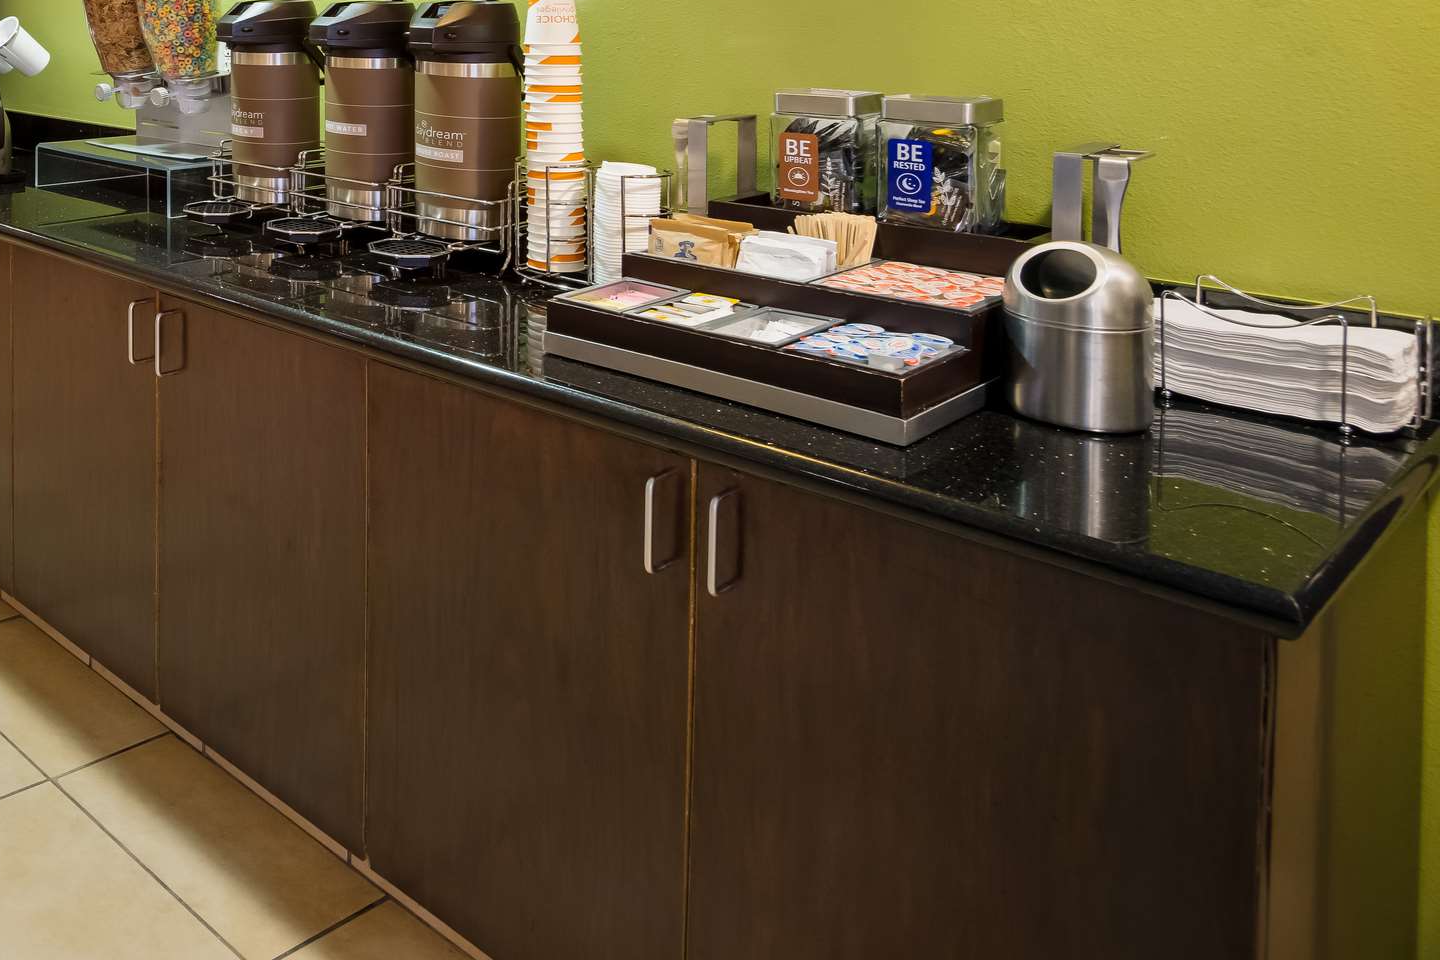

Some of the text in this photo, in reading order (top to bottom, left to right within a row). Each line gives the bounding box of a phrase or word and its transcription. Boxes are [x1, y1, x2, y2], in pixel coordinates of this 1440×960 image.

[536, 15, 577, 24] CHOICE
[425, 138, 463, 148] BLEND
[785, 139, 812, 157] BE
[897, 143, 923, 162] BE
[783, 155, 813, 165] UPBEAT
[893, 160, 926, 172] RESTED
